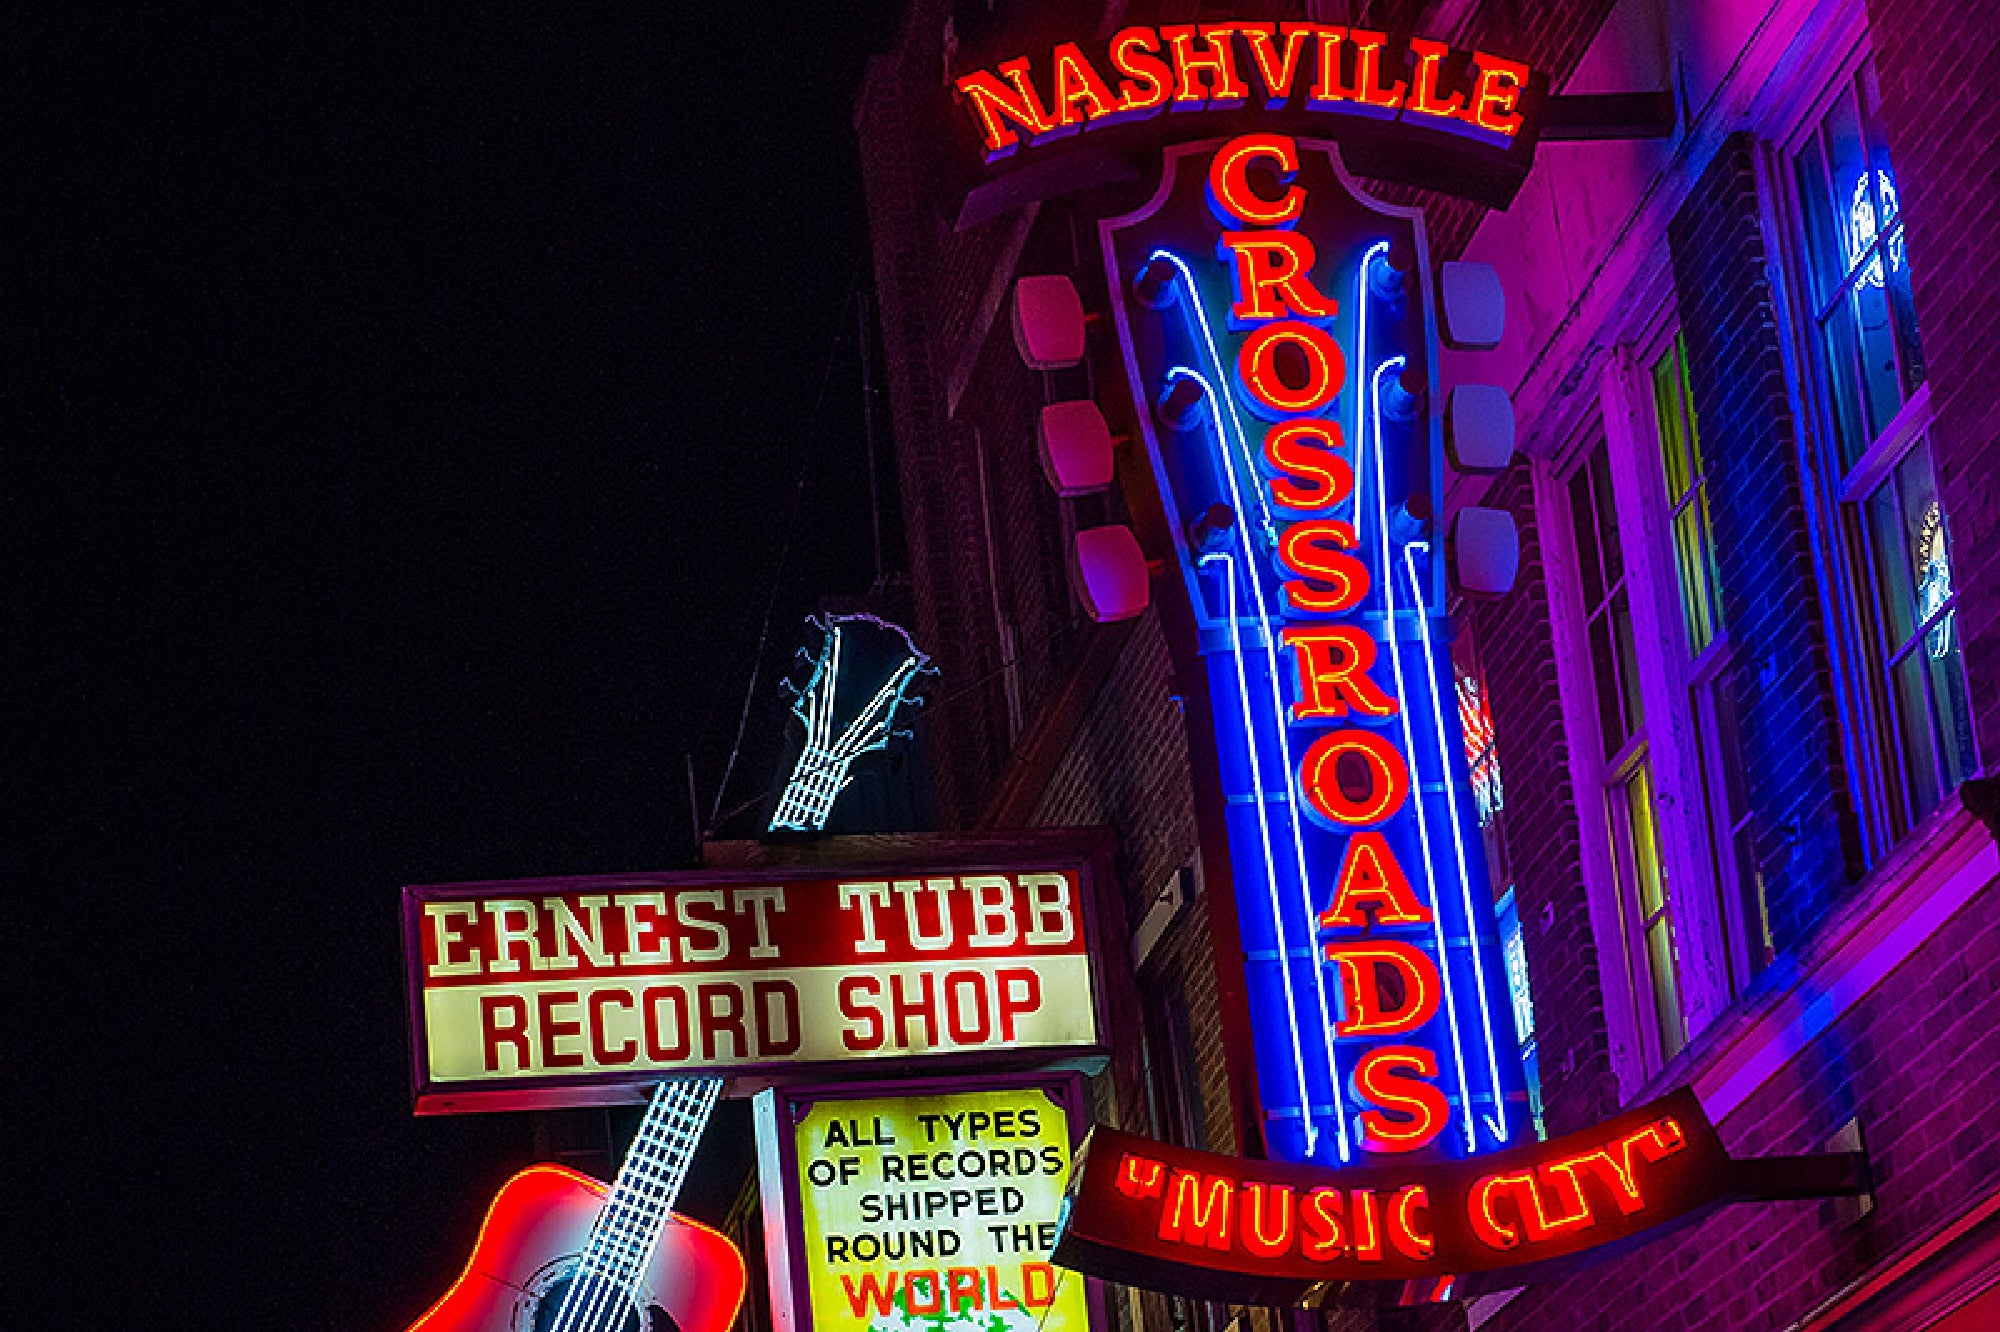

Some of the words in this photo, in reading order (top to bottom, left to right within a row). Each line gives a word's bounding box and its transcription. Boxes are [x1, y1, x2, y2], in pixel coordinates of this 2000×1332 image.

[957, 21, 1530, 149] NASHVILLE
[1208, 134, 1450, 1153] CROSSROADS
[424, 888, 785, 976] ERNEST
[839, 872, 1074, 953] TUBB
[483, 981, 800, 1071] RECORD
[840, 968, 1041, 1052] SHOP
[824, 1119, 896, 1148] ALL
[918, 1109, 1042, 1140] TYPES
[808, 1157, 860, 1186] OF
[882, 1146, 1064, 1182] RECORDS
[859, 1187, 1025, 1222] SHIPPED
[826, 1229, 962, 1263] ROUND
[988, 1221, 1057, 1252] THE
[840, 1262, 1057, 1319] WORLD
